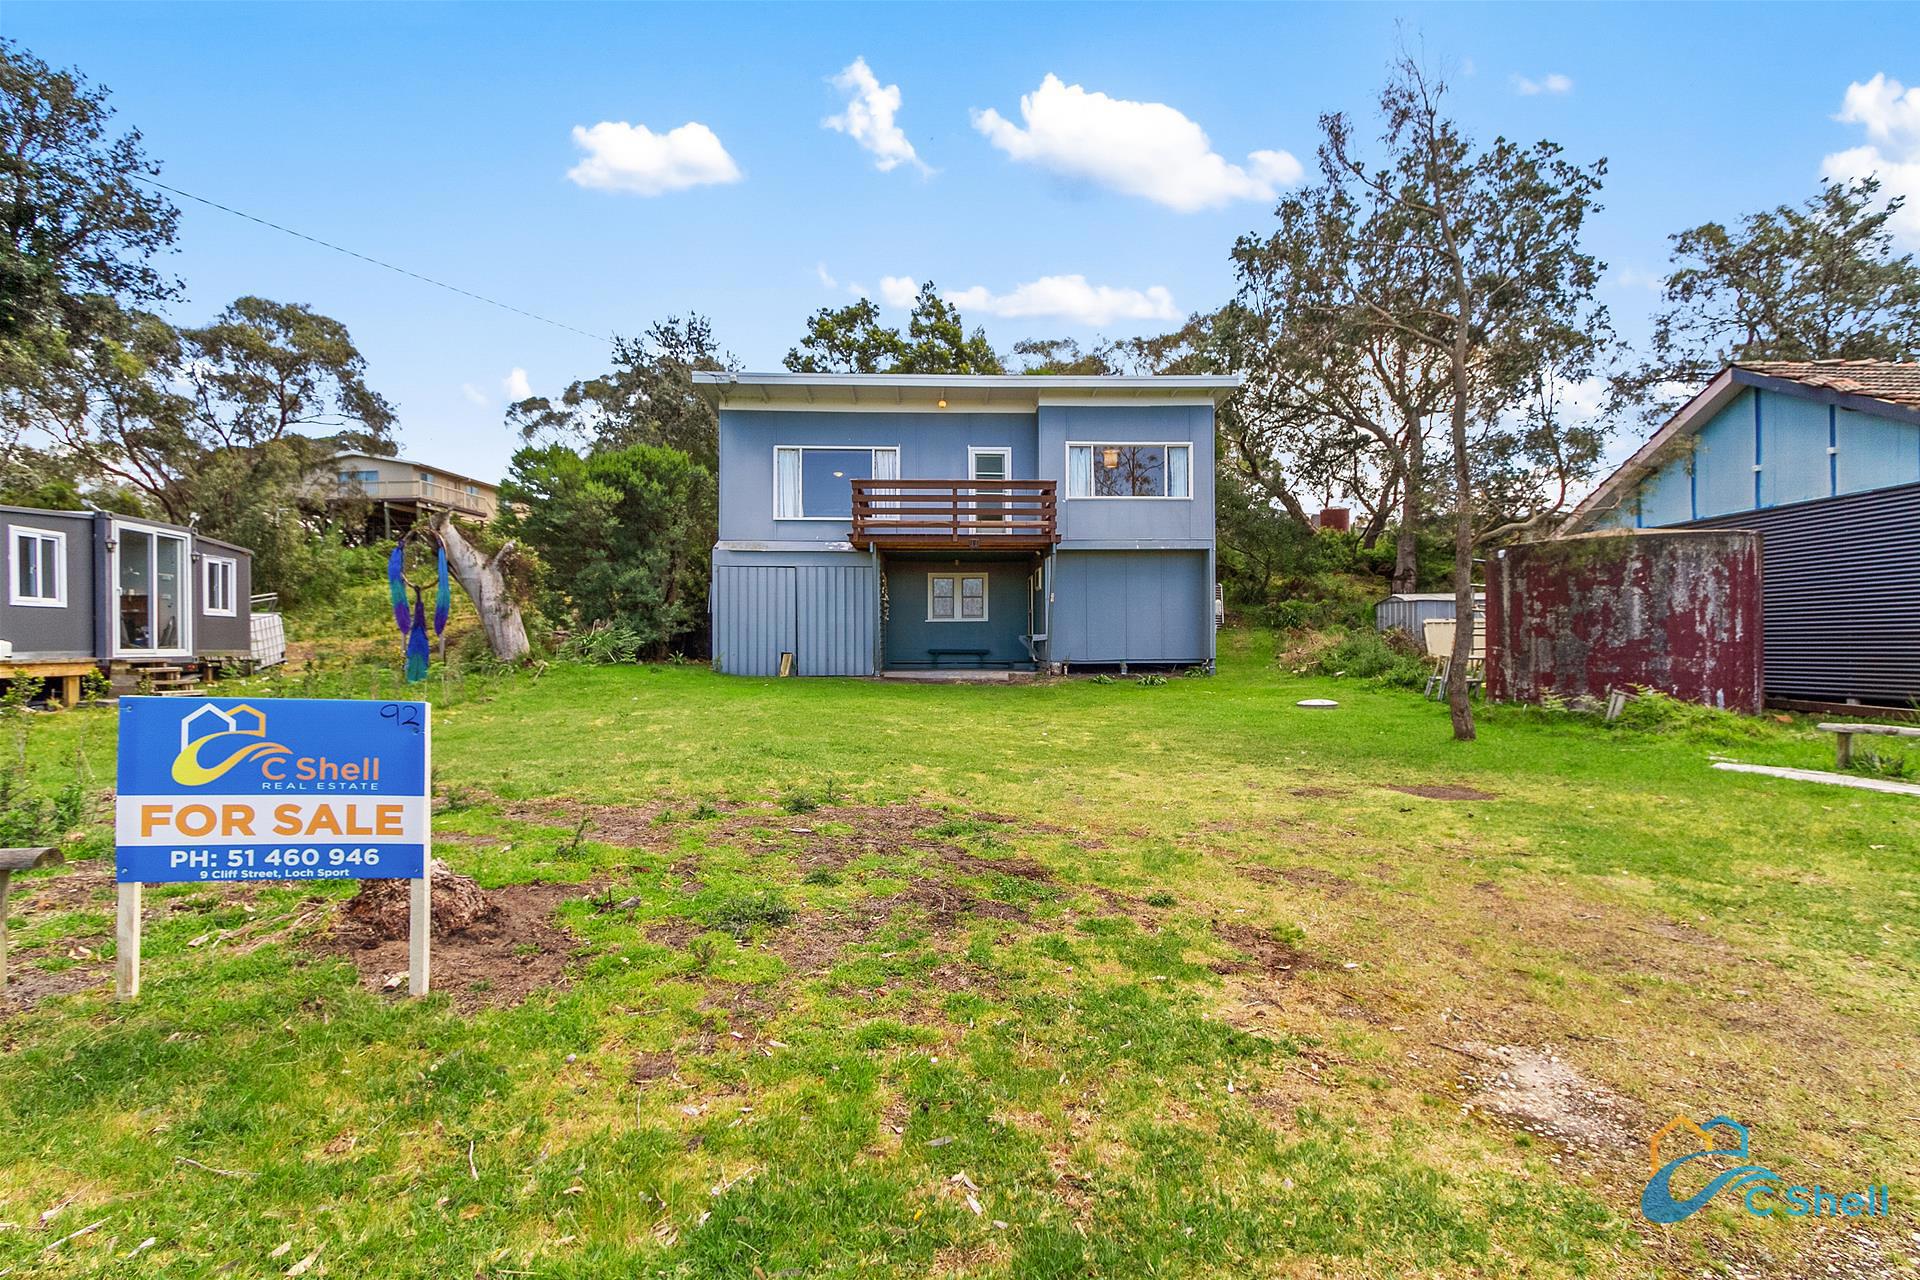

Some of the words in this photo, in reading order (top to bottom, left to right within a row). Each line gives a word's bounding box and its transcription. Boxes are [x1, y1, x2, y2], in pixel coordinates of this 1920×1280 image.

[380, 704, 420, 726] 92
[262, 758, 286, 781] C
[296, 758, 379, 781] Shell
[317, 782, 378, 790] ESTATE
[141, 804, 256, 837] FOR
[273, 804, 404, 835] SALE
[171, 851, 217, 868] PH:
[227, 850, 253, 867] 51
[264, 849, 320, 866] 460
[329, 848, 379, 865] 946
[200, 871, 208, 879] 9
[212, 870, 238, 879] Cliff
[241, 869, 282, 880] Street,
[285, 869, 314, 877] Loch
[317, 868, 349, 879] Sport
